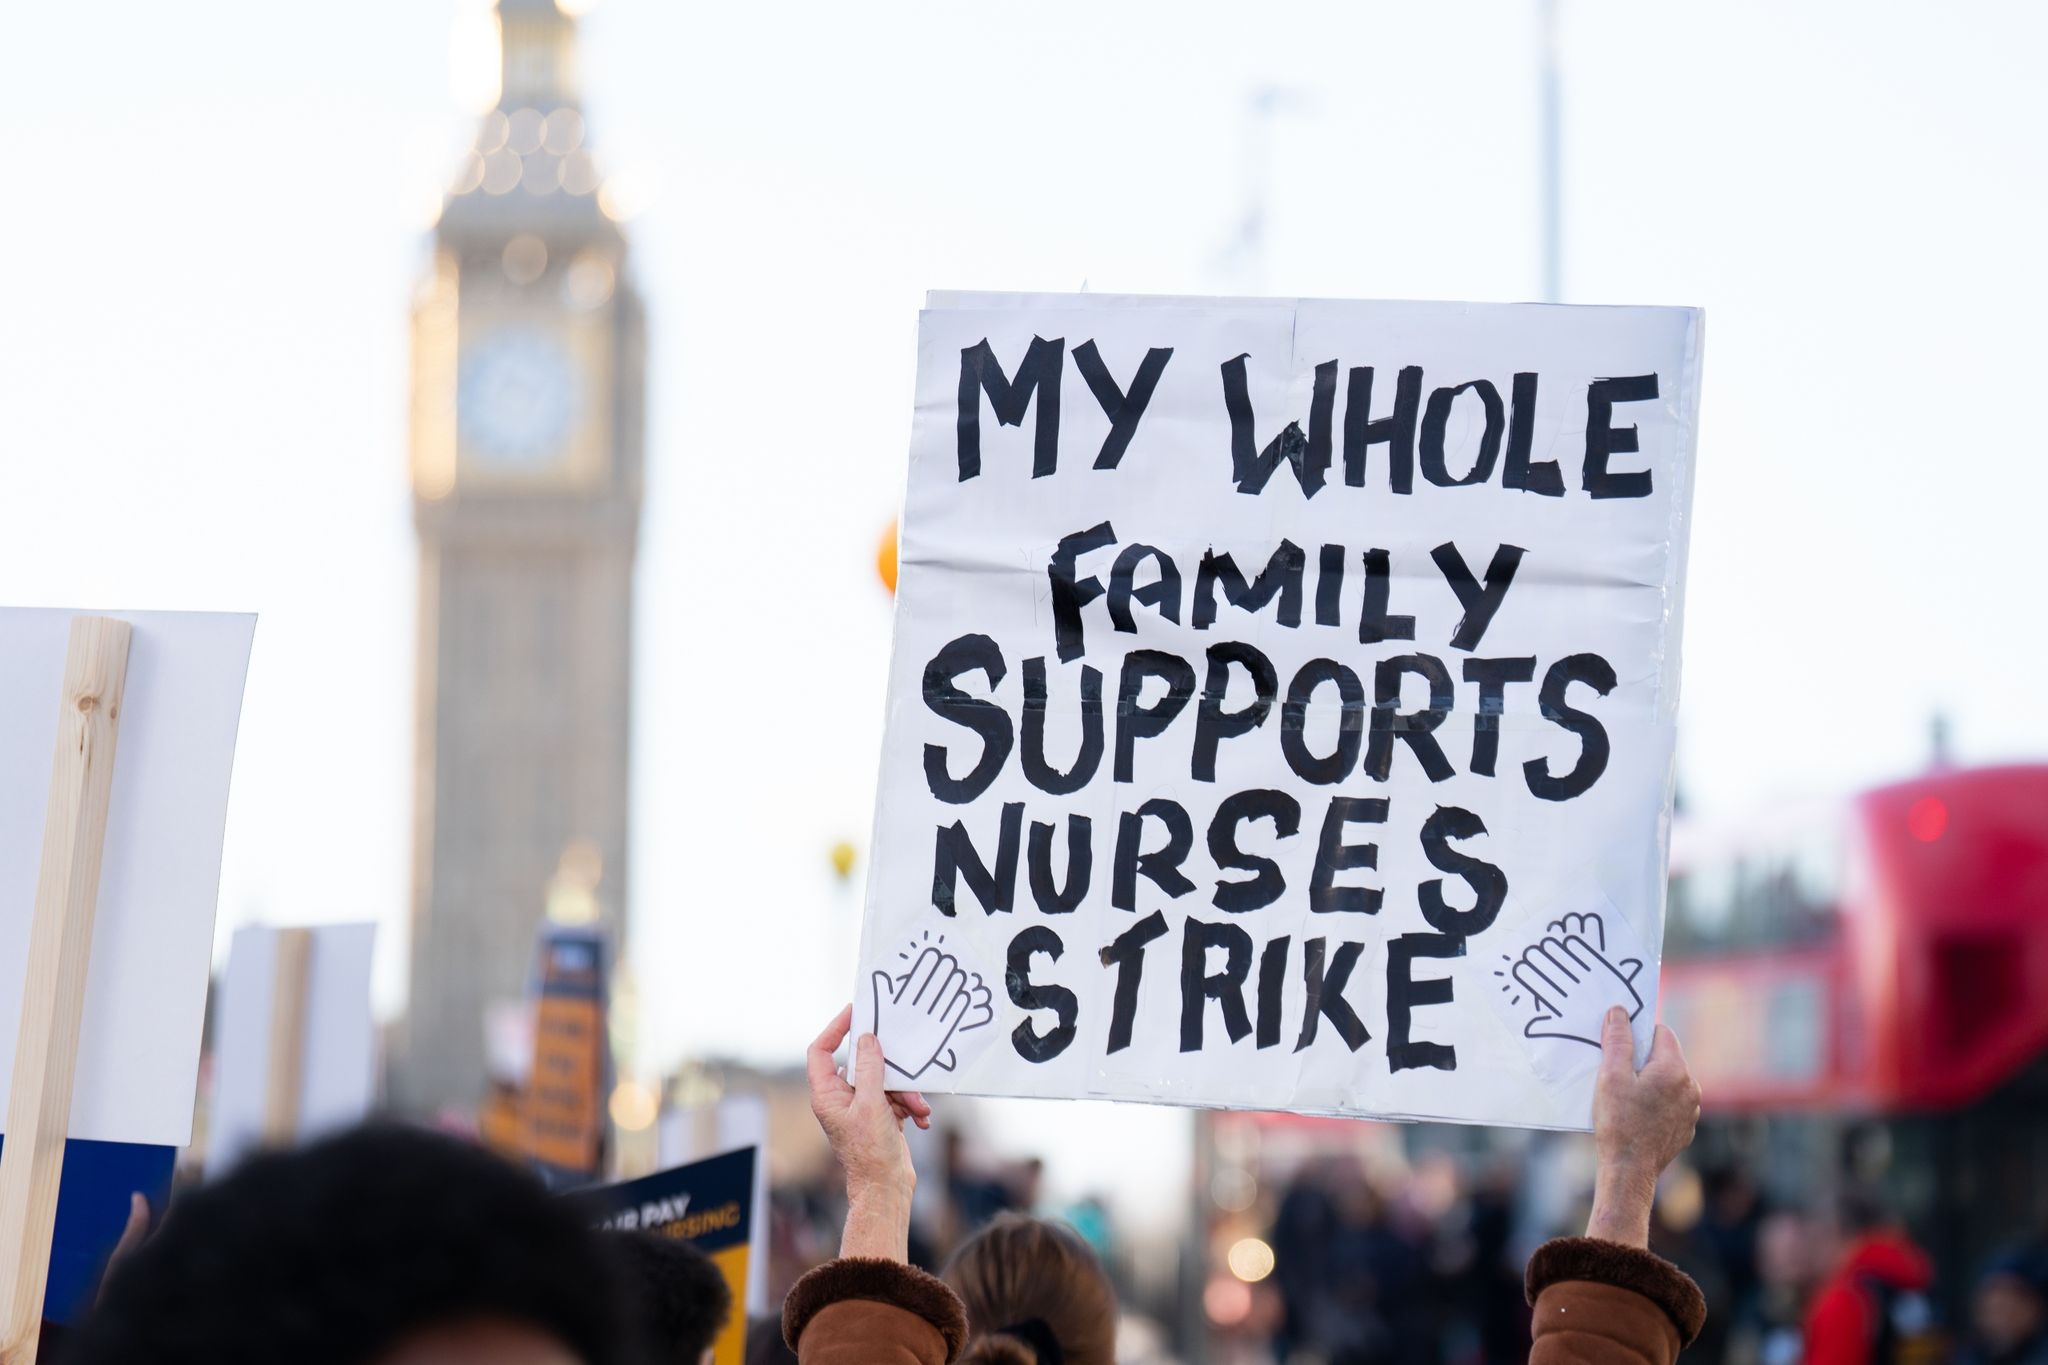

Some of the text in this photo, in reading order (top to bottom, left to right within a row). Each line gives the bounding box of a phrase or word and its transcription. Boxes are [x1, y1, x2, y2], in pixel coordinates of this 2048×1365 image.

[958, 334, 1659, 500] MY WHOLE
[1048, 520, 1530, 664] FAMILY
[922, 633, 1618, 804] SUPPORTS
[932, 789, 1508, 936] NURSES
[1005, 909, 1467, 1072] STRIKE
[589, 1192, 691, 1231] AIR PAY
